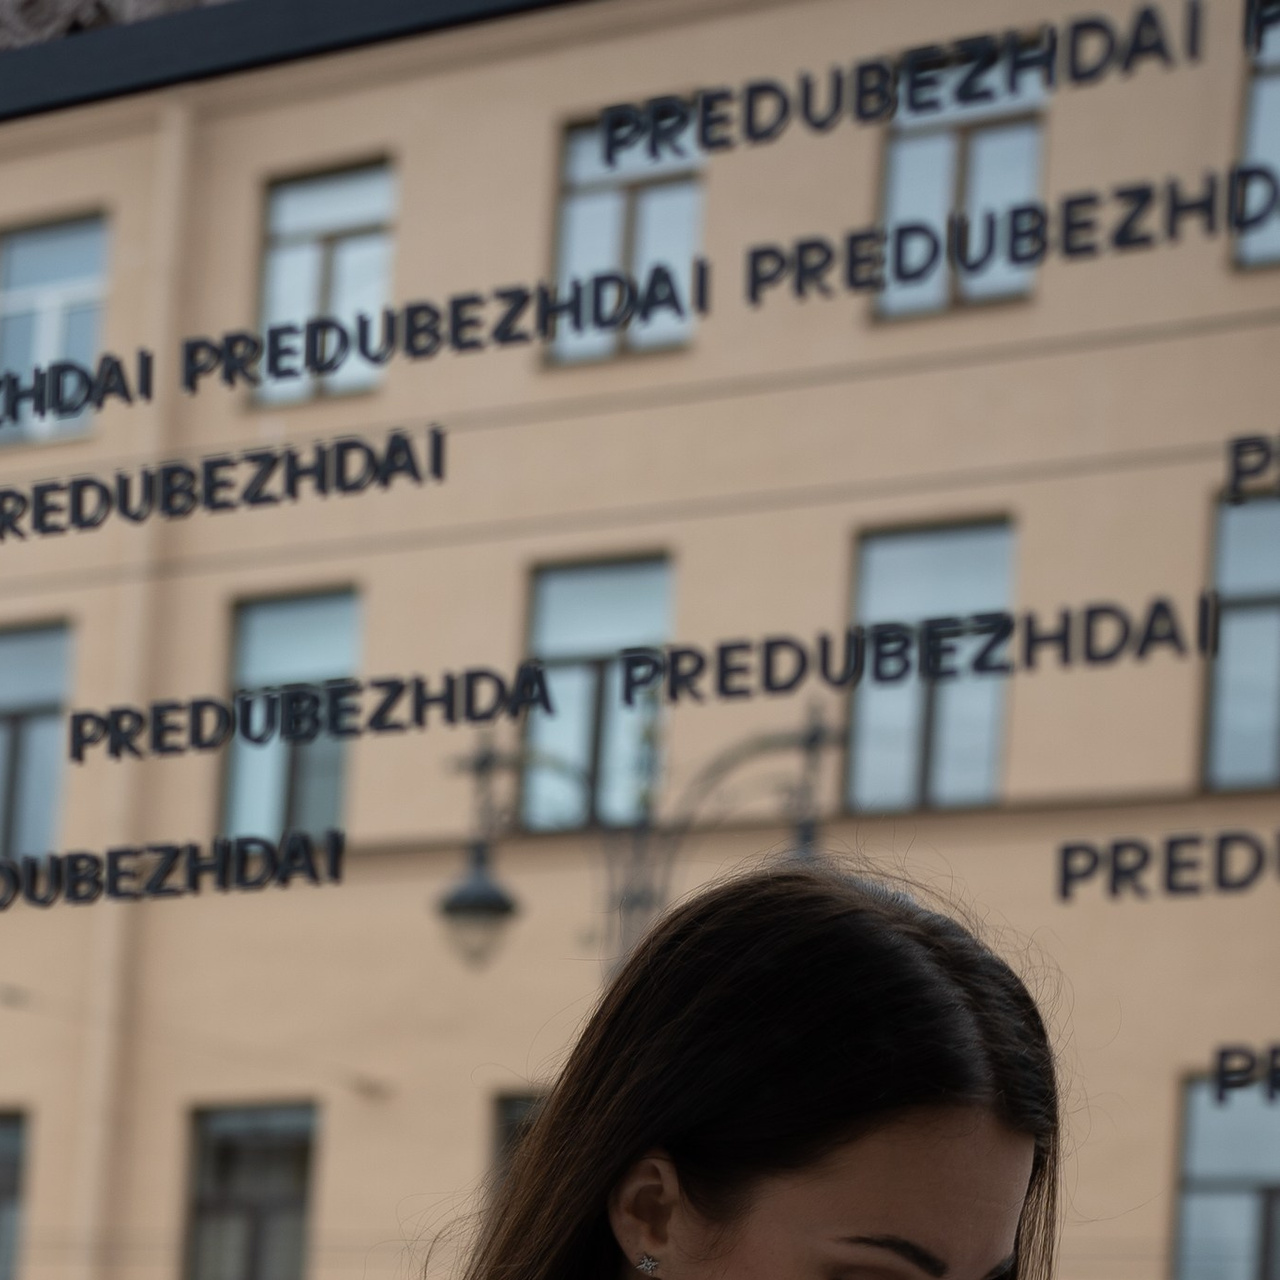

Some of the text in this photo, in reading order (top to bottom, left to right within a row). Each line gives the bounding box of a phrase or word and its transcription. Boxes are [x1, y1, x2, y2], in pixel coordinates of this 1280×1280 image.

[600, 0, 1204, 167] PREDUBEZHDAI
[181, 256, 710, 394] PREDUBEZHDAI
[622, 588, 1221, 710] PREDUBEZHDAI
[1056, 829, 1280, 903] PRED
